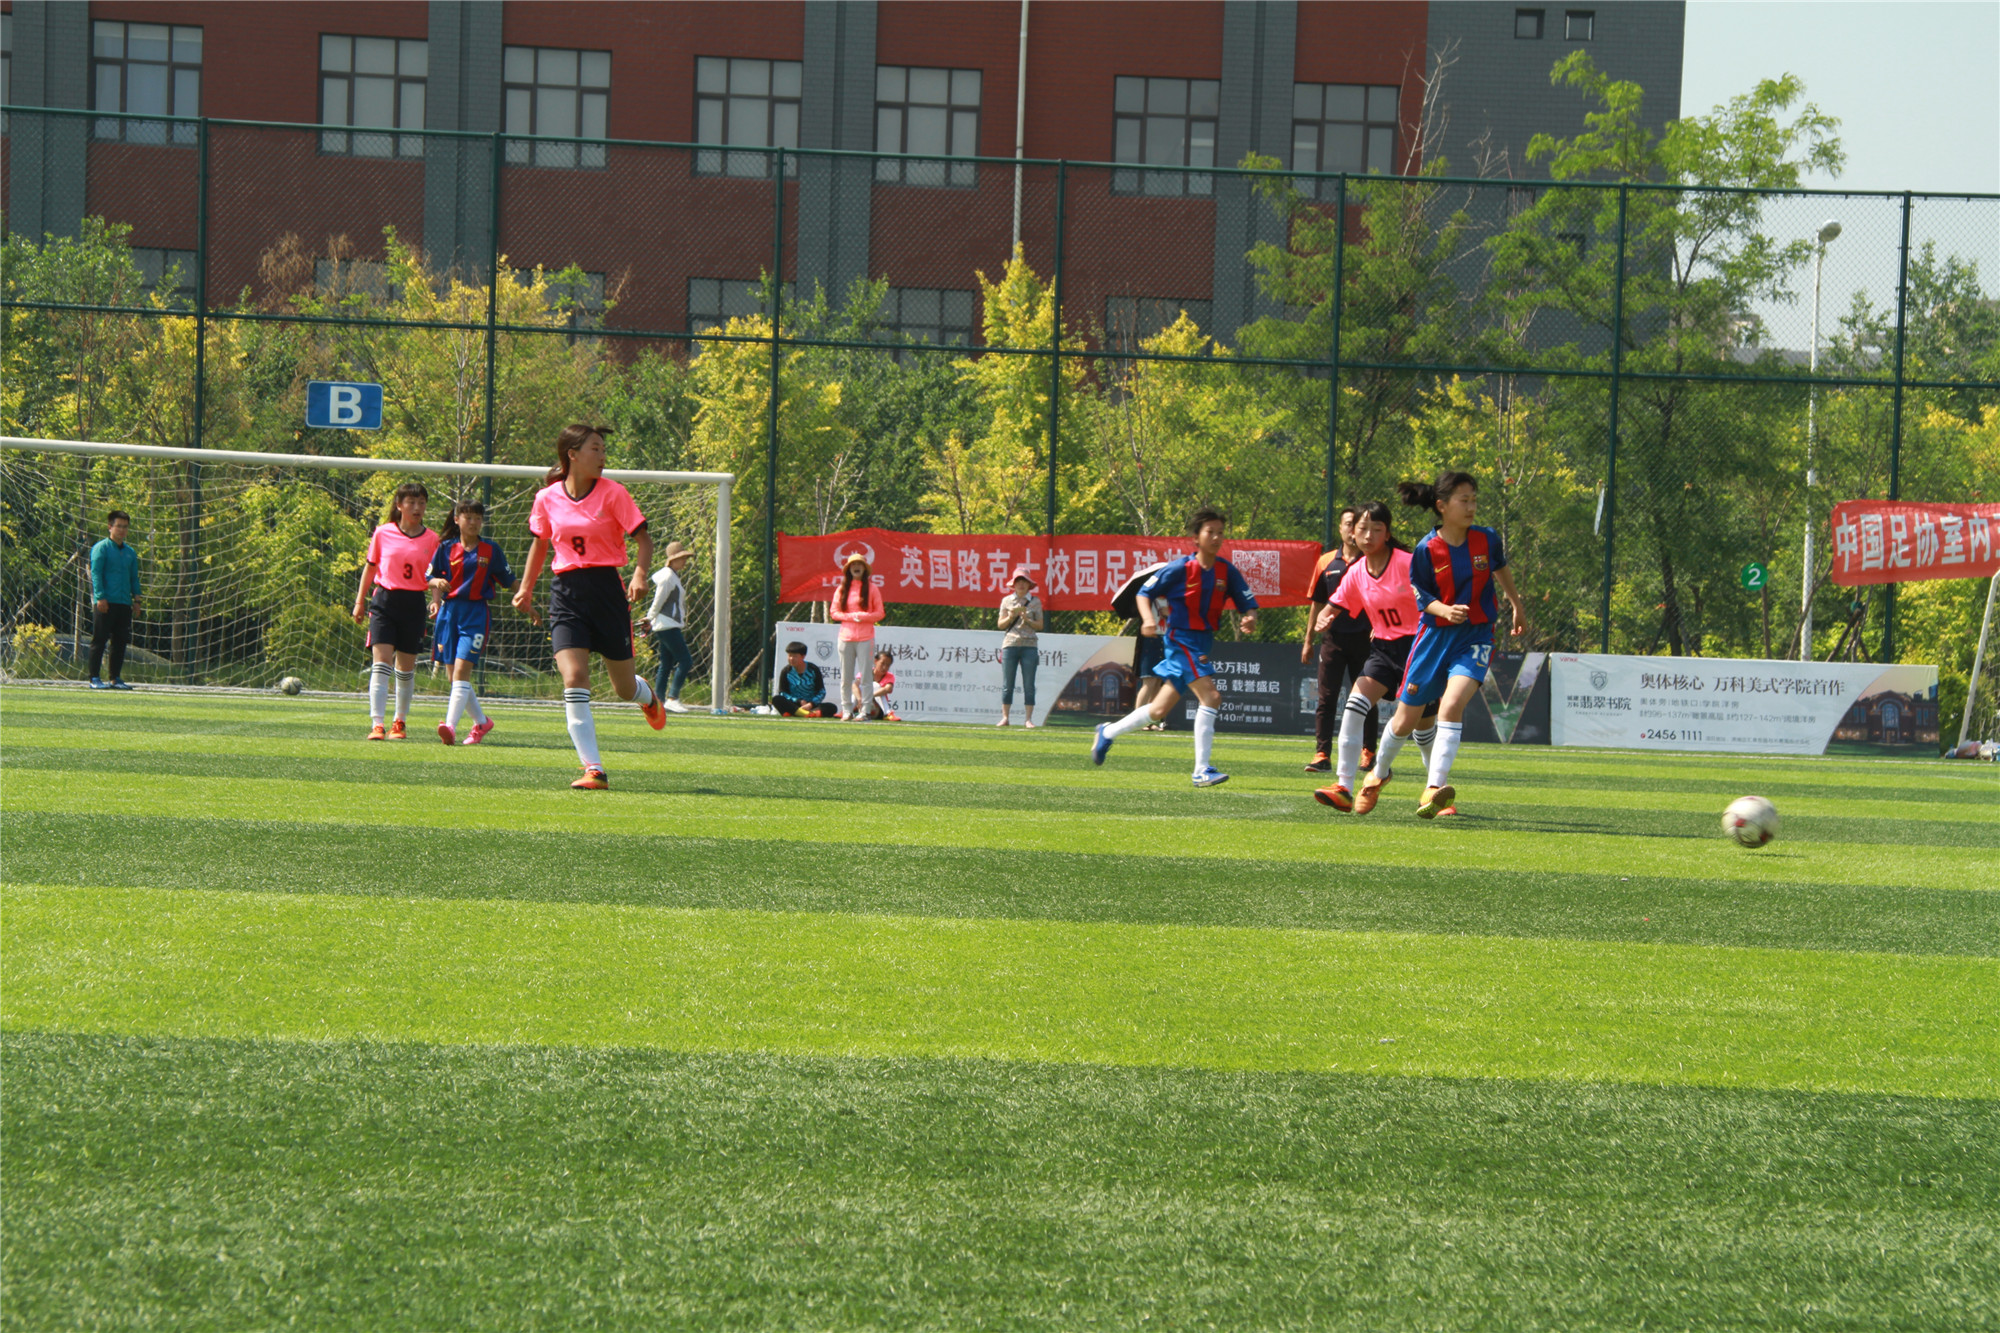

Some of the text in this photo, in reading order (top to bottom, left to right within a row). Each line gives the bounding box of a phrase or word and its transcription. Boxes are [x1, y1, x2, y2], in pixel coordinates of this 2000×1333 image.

[329, 386, 362, 424] B
[571, 536, 585, 556] 8
[1836, 511, 2000, 573] 中国足协室内
[402, 563, 413, 579] 3
[1747, 567, 1761, 586] 2
[822, 574, 885, 588] LOS
[1378, 608, 1402, 628] 10
[472, 633, 484, 650] 8
[876, 643, 1068, 668] 体核心 万科美式首作
[1471, 644, 1492, 664] 13
[1210, 660, 1261, 675] 达万科城
[1641, 672, 1846, 697] 奥体核心 万科美式学院首作
[903, 700, 925, 711] 1111
[1647, 729, 1677, 741] 2456
[1682, 730, 1702, 742] 1111
